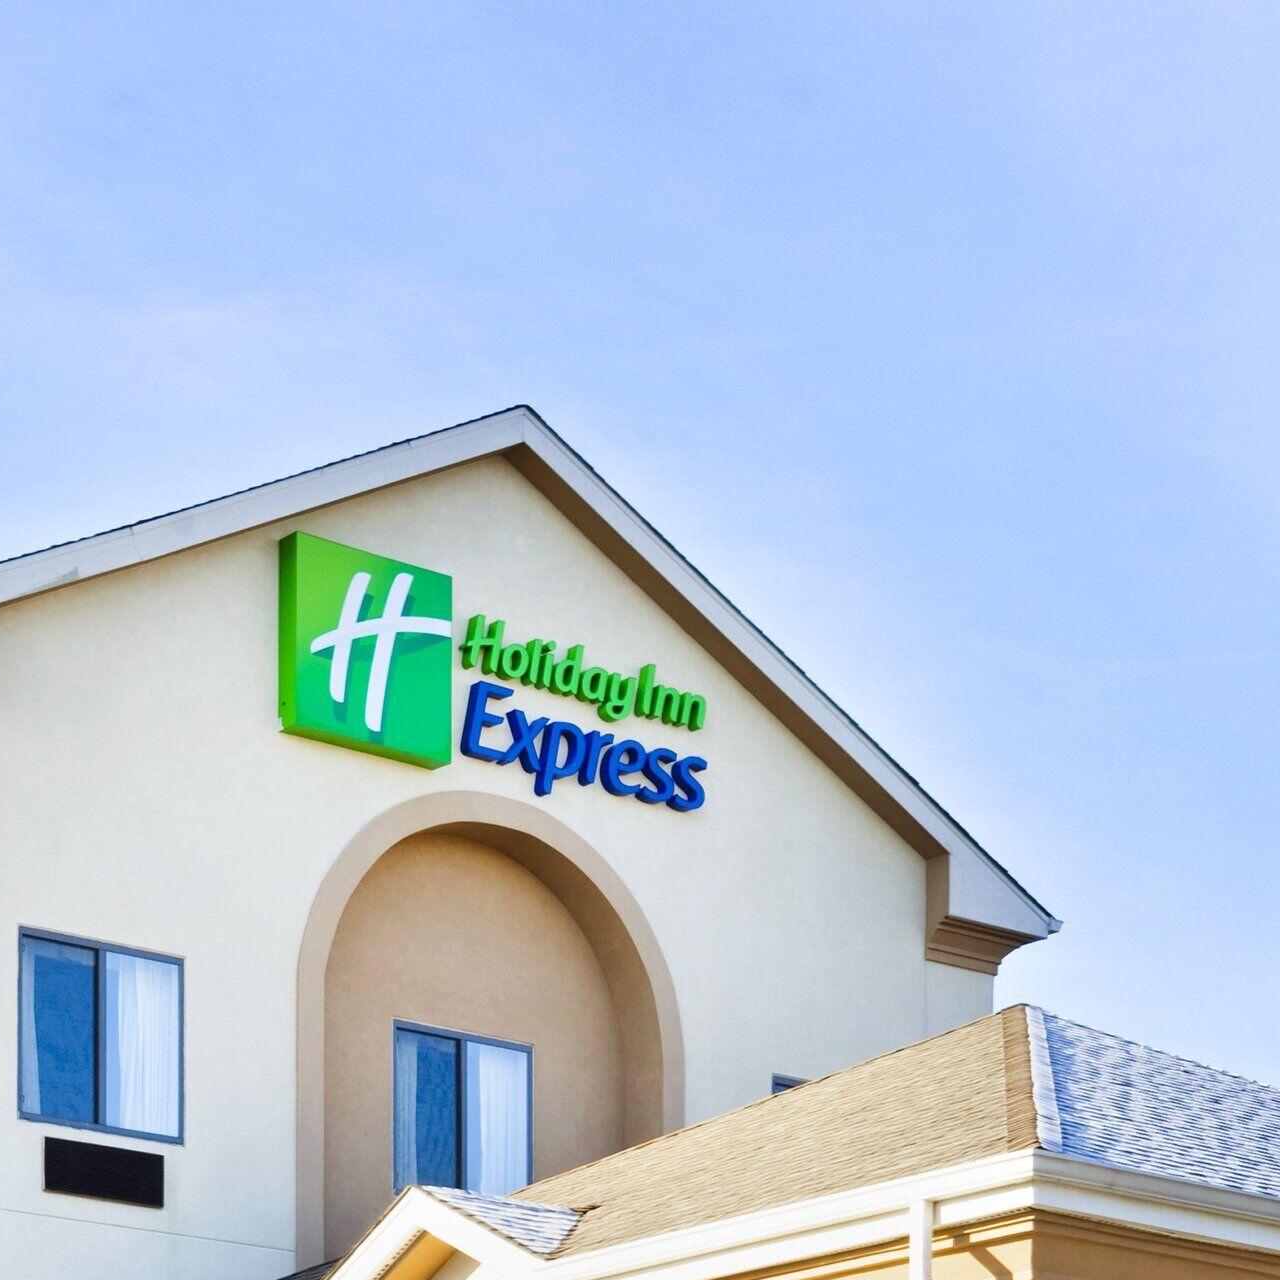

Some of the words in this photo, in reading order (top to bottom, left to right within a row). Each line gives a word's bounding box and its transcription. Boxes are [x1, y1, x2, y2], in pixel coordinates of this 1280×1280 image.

[310, 571, 452, 733] H
[459, 614, 637, 723] Holiday
[634, 663, 708, 732] Inn
[460, 680, 708, 812] Express
